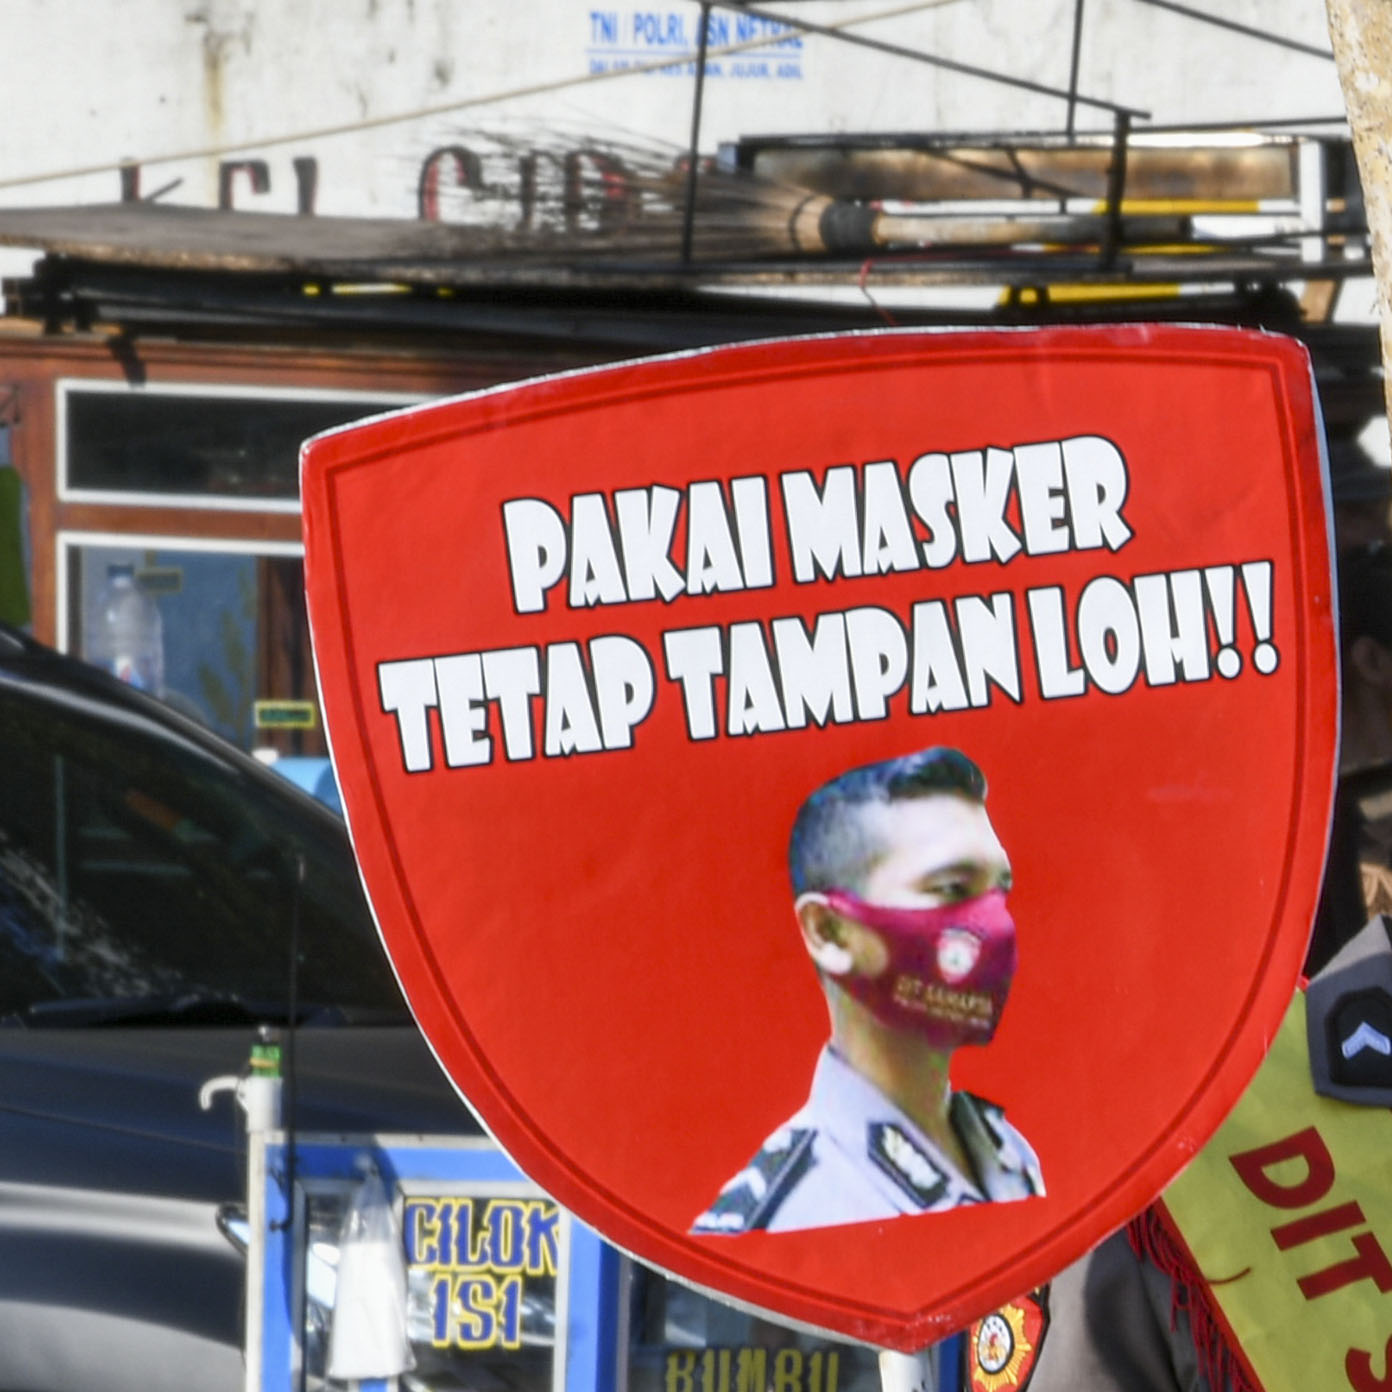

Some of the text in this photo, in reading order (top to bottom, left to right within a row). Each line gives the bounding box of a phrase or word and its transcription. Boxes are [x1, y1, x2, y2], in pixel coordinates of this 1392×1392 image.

[696, 14, 730, 47] SN
[502, 434, 1135, 614] PAKAI MASKER
[376, 559, 1281, 774] TETAP TAMPAN LOH!!
[403, 1197, 560, 1277] CILOK
[431, 1272, 523, 1350] ISI
